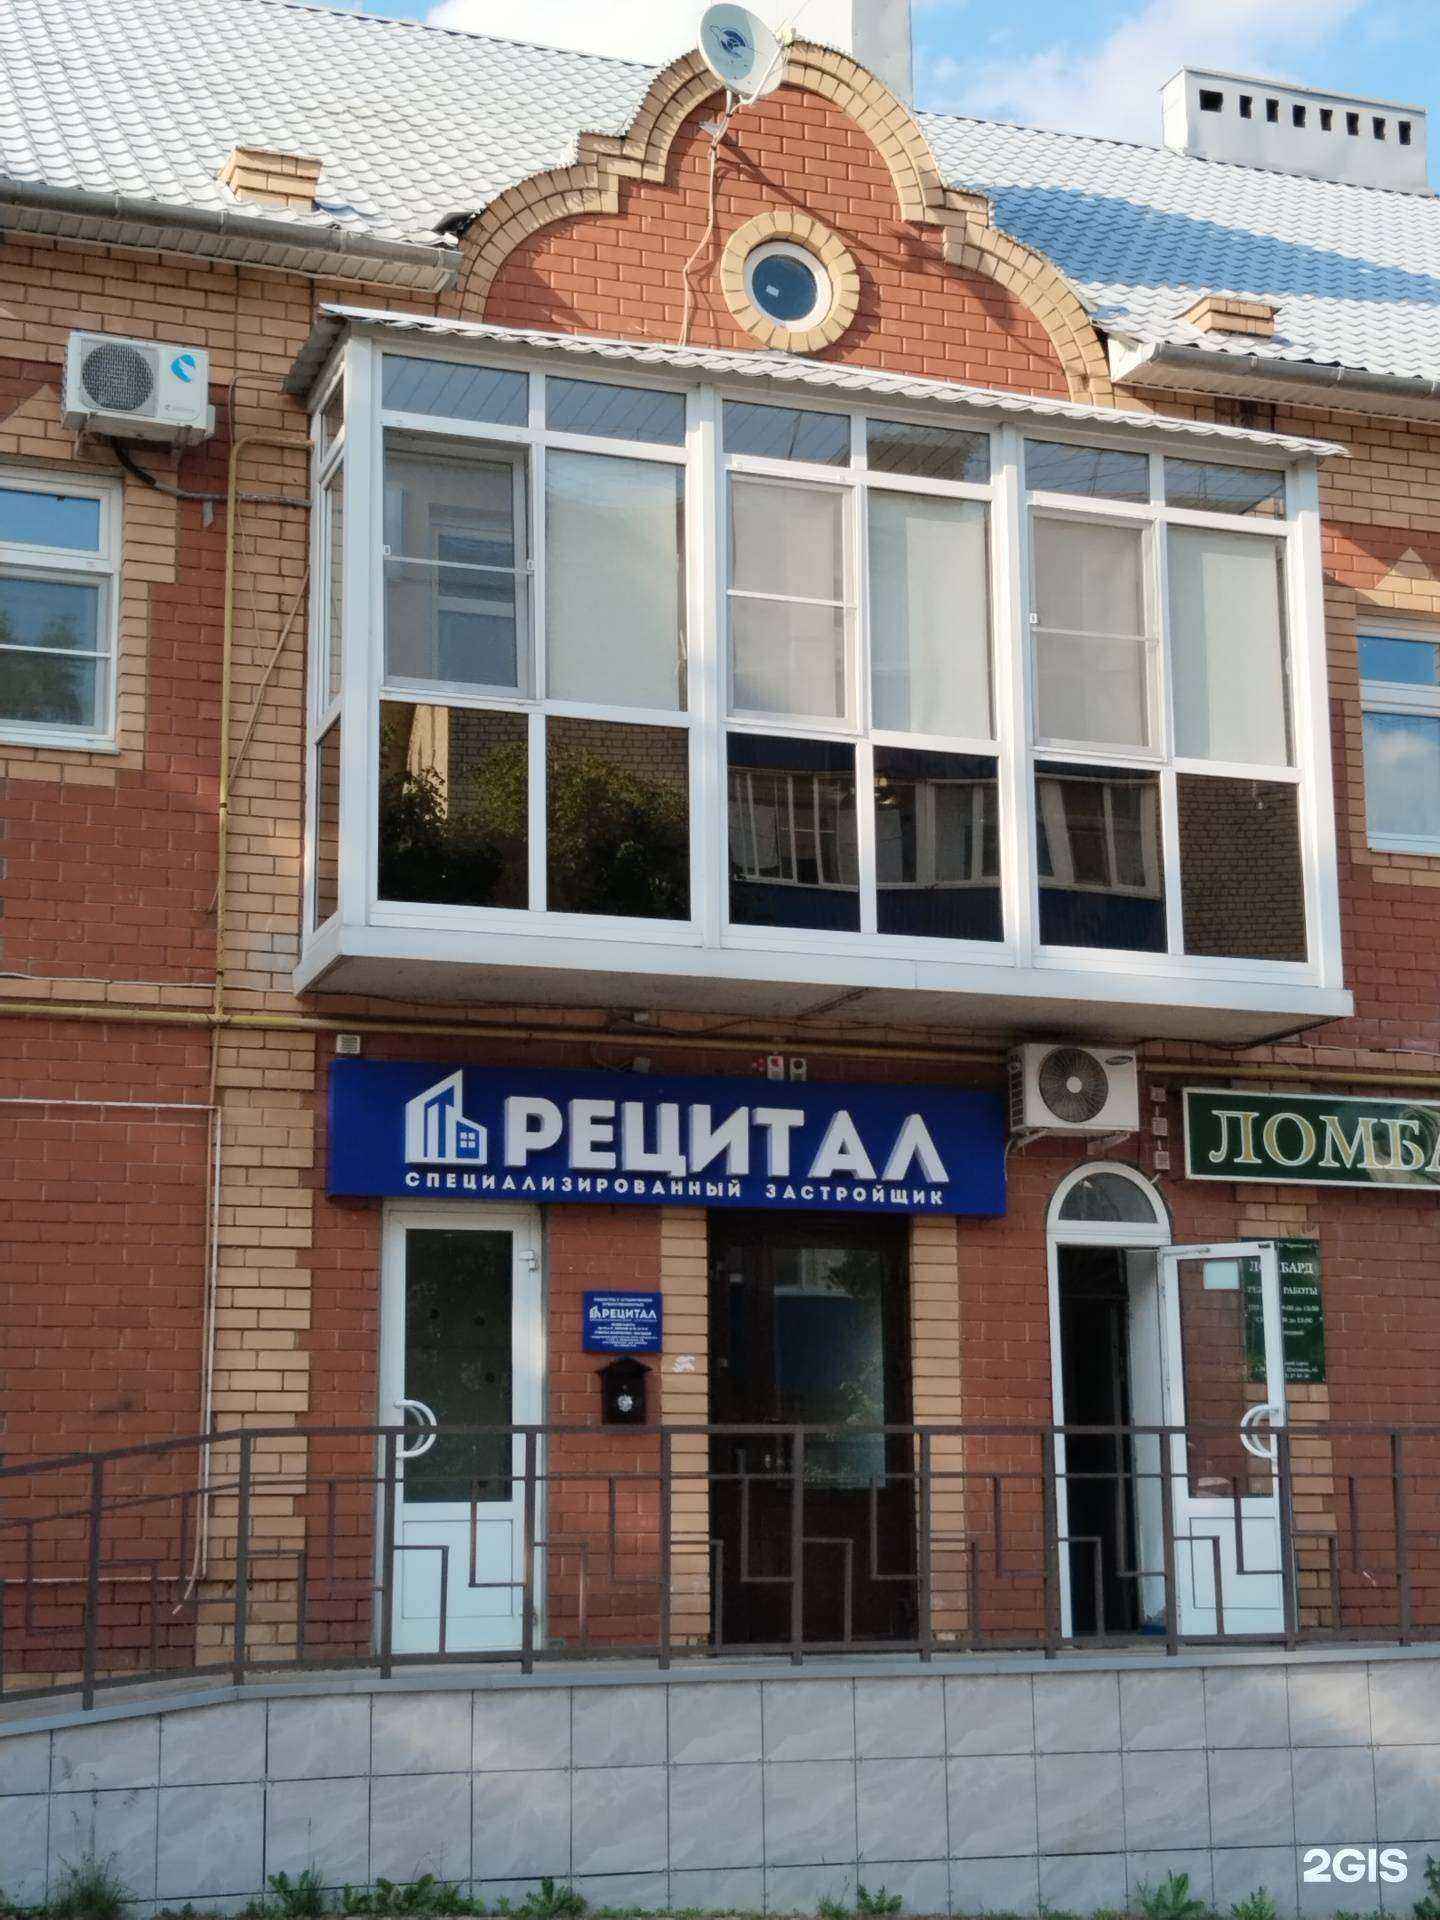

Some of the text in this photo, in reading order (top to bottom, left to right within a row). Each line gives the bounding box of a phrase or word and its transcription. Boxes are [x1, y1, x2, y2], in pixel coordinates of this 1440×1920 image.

[504, 1096, 949, 1183] РЕЦИТАЛ
[404, 1171, 943, 1205] СПЕЦИАЛИЗИРОВАННЫЙ ЗАСТРОЙЩИК
[602, 1308, 657, 1319] РЕЦИТАЛ
